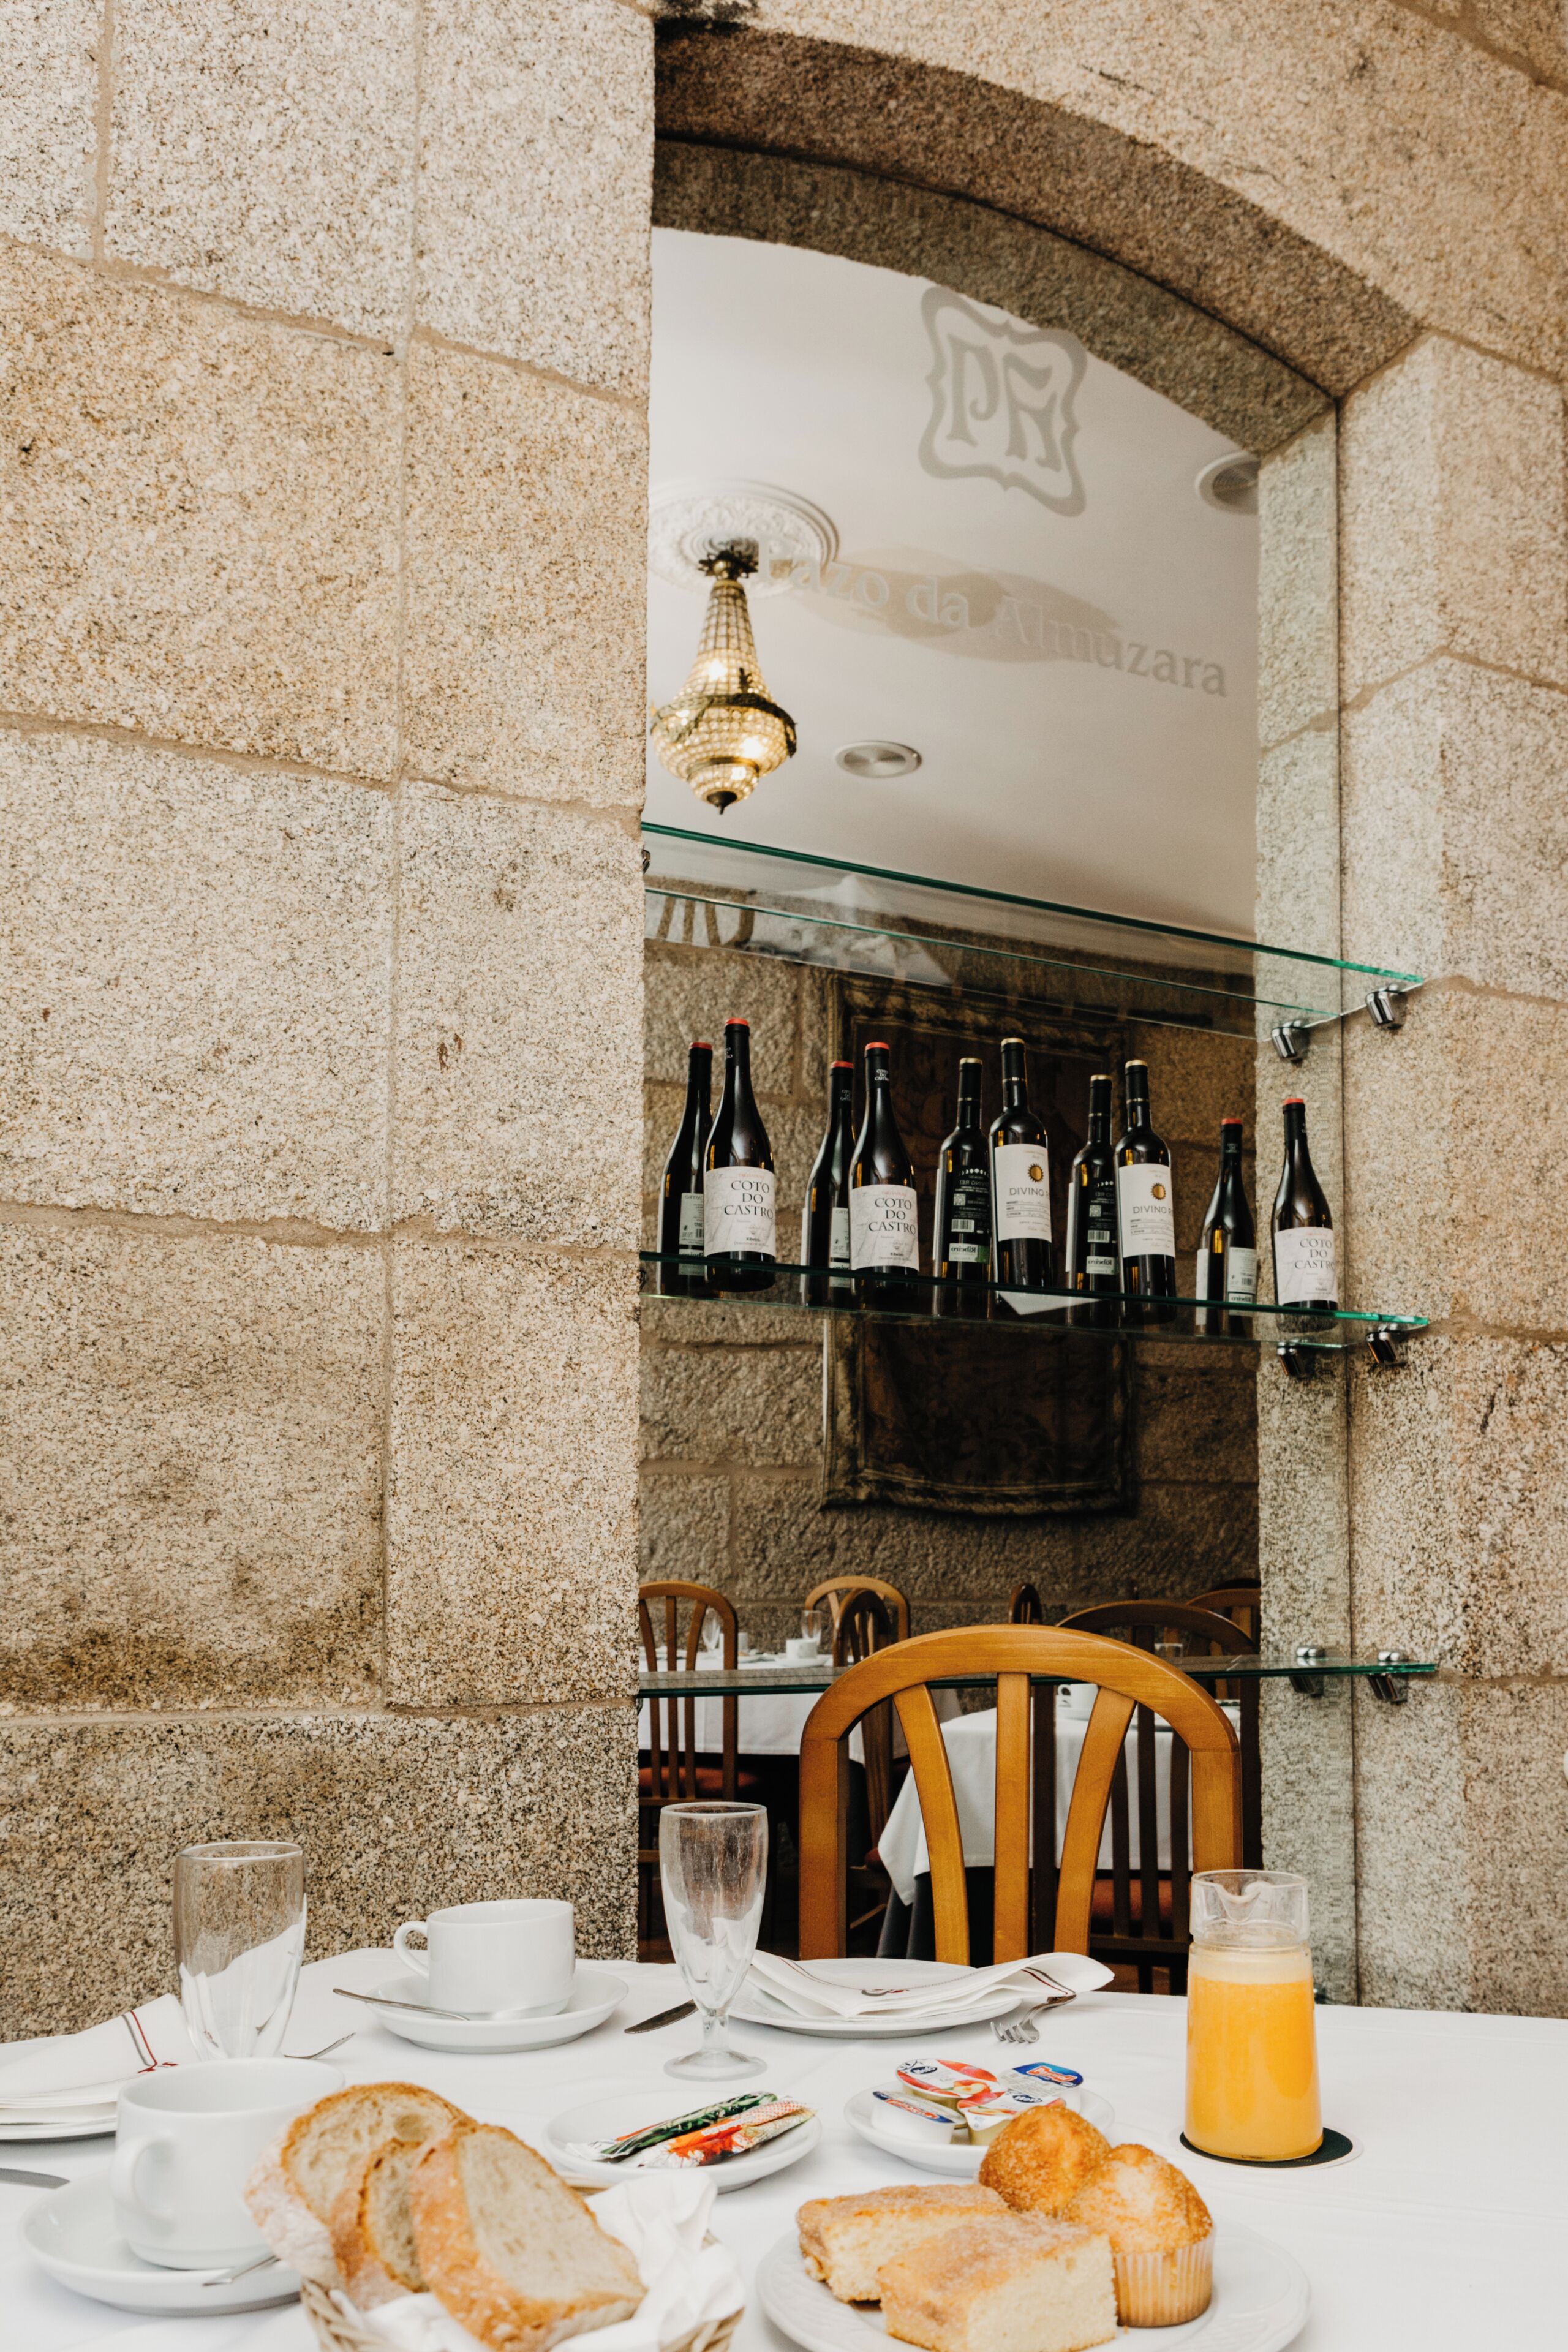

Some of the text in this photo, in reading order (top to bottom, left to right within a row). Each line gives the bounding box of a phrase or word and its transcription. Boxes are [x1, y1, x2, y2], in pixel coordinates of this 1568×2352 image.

[758, 535, 1227, 698] Pazo da Almuzara
[731, 1180, 770, 1194] COTO
[1009, 1187, 1044, 1197] DIVINO
[742, 1193, 763, 1204] DO
[875, 1197, 912, 1210] COTO
[724, 1204, 773, 1219] CASTRO
[886, 1209, 906, 1220] DO
[1133, 1205, 1167, 1214] DIVINO
[869, 1221, 916, 1235] CASTRO
[1299, 1238, 1332, 1249] COTO
[1310, 1249, 1328, 1258] DO
